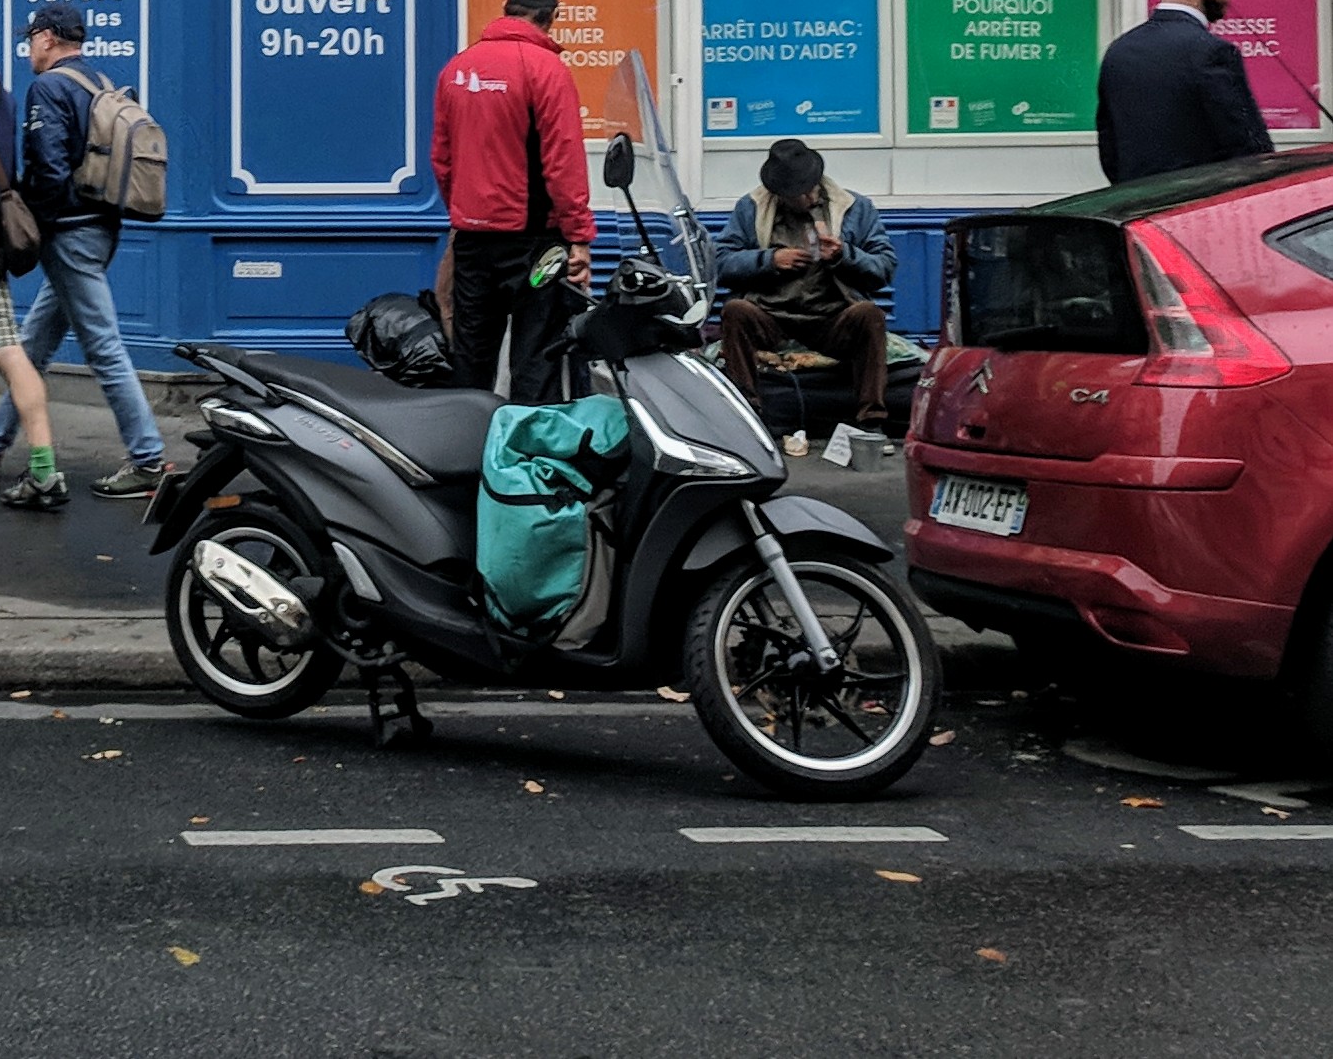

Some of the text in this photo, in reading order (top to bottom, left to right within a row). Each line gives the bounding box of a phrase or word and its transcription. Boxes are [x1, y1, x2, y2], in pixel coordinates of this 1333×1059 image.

[86, 9, 122, 27] les
[964, 16, 1042, 37] ARRÊTER
[701, 19, 755, 40] ARRÊT
[760, 22, 788, 38] DU
[260, 27, 384, 56] 9h-20h
[704, 44, 775, 62] BESOIN
[950, 43, 975, 59] DE
[980, 43, 1042, 60] FUMER
[1069, 388, 1110, 404] C4
